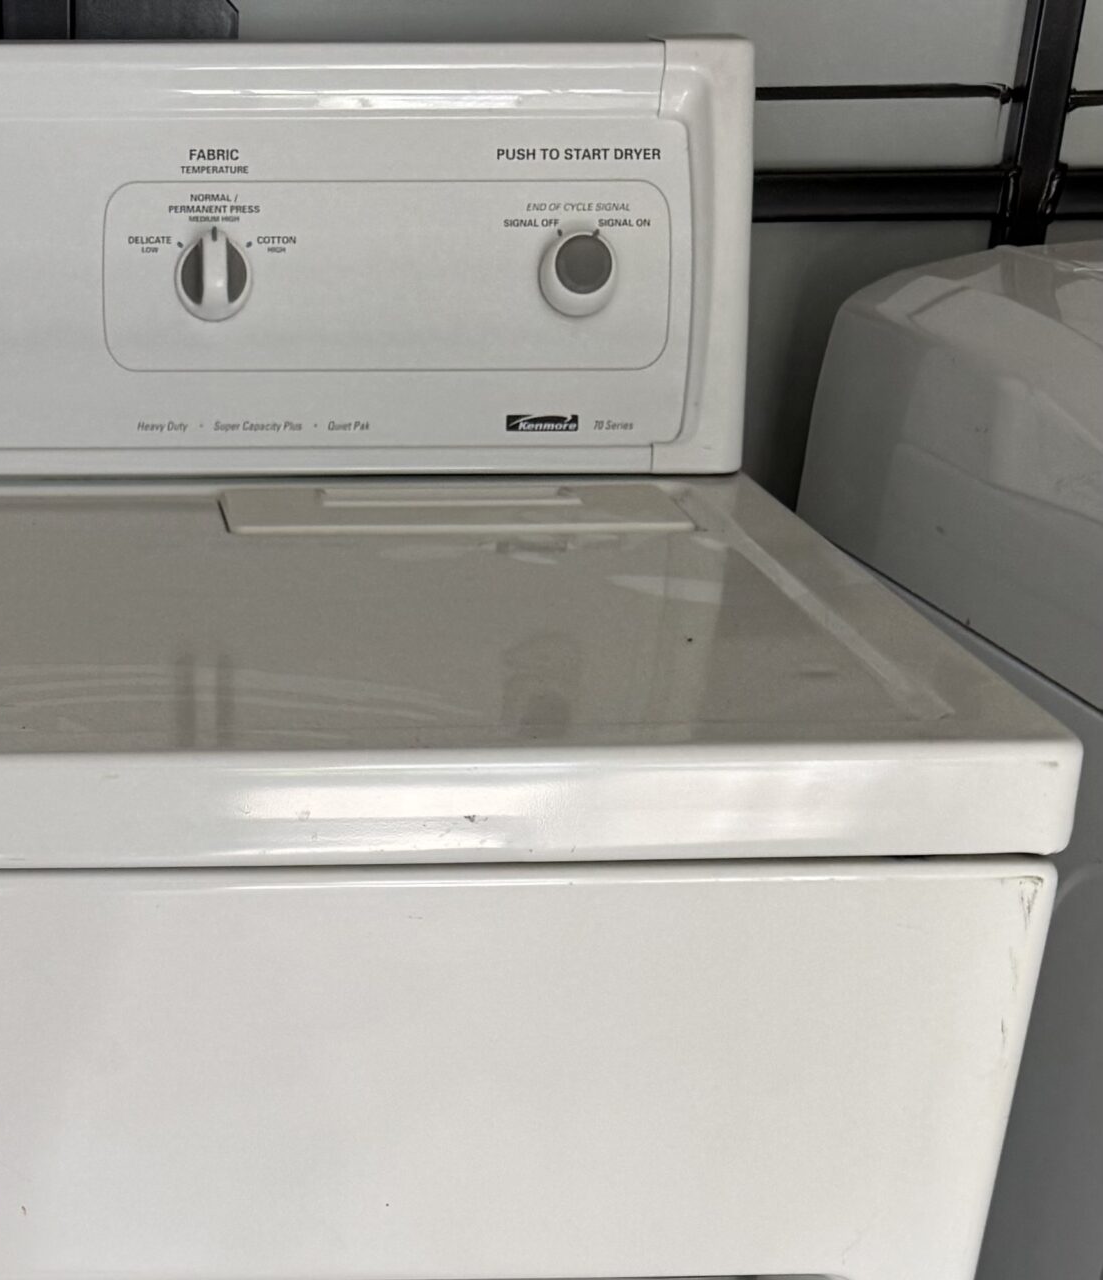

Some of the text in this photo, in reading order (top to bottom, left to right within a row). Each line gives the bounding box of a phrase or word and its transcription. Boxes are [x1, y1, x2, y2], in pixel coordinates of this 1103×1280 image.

[188, 148, 239, 161] FABRIC
[497, 148, 661, 161] PUSH TO START DRYER
[180, 166, 249, 175] TEMPERATURE
[190, 194, 231, 202] NORMAL
[169, 205, 260, 214] PERMANENT PRESS
[526, 203, 630, 212] END OF CYCLE SIGNAL
[504, 219, 560, 228] SIGNAL OFF
[598, 218, 651, 228] SIGNAL ON
[128, 236, 172, 245] DELICATE
[257, 236, 297, 245] COTTON
[137, 421, 188, 432] Heavy Duty
[214, 421, 302, 432] Super Capacity Plus
[328, 421, 370, 431] Quiet Pak
[518, 421, 578, 432] Kenmore
[594, 421, 634, 430] 70 Series
